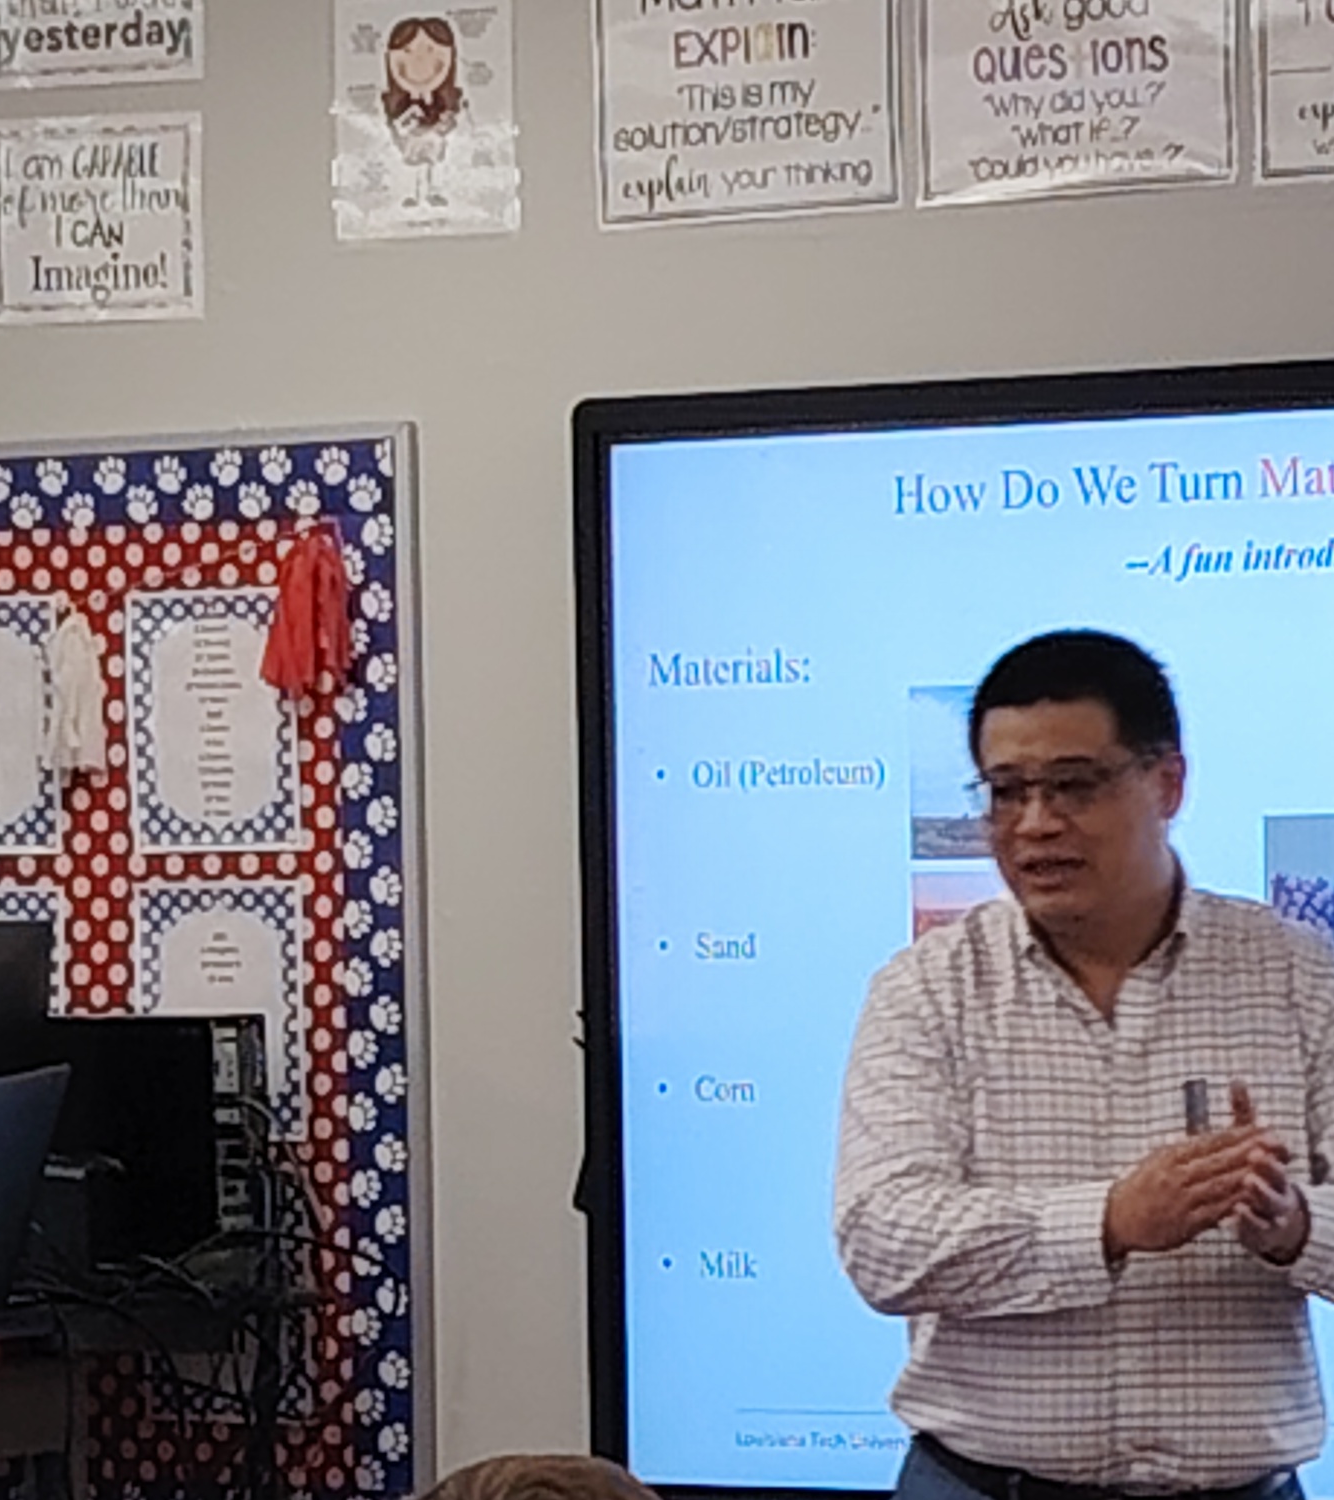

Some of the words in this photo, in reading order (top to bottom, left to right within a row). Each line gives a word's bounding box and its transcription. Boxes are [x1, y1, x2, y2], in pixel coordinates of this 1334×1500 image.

[741, 82, 764, 109] is
[769, 78, 816, 109] my
[1048, 86, 1085, 114] did
[22, 152, 64, 182] am
[72, 142, 160, 180] CAPABLE
[622, 154, 711, 213] explain
[720, 164, 777, 196] your
[784, 159, 874, 188] thinking
[71, 216, 124, 249] CAN
[894, 473, 987, 516] How
[1001, 468, 1059, 510] Do
[1073, 465, 1137, 507] We
[1150, 461, 1243, 503] Turn
[1174, 542, 1234, 582] fun
[648, 647, 811, 688] Materials:
[692, 759, 732, 789] Oil
[738, 756, 886, 794] (Petroleum)
[693, 931, 758, 961] Sand
[693, 1074, 756, 1103] Corn
[698, 1250, 759, 1280] Milk
